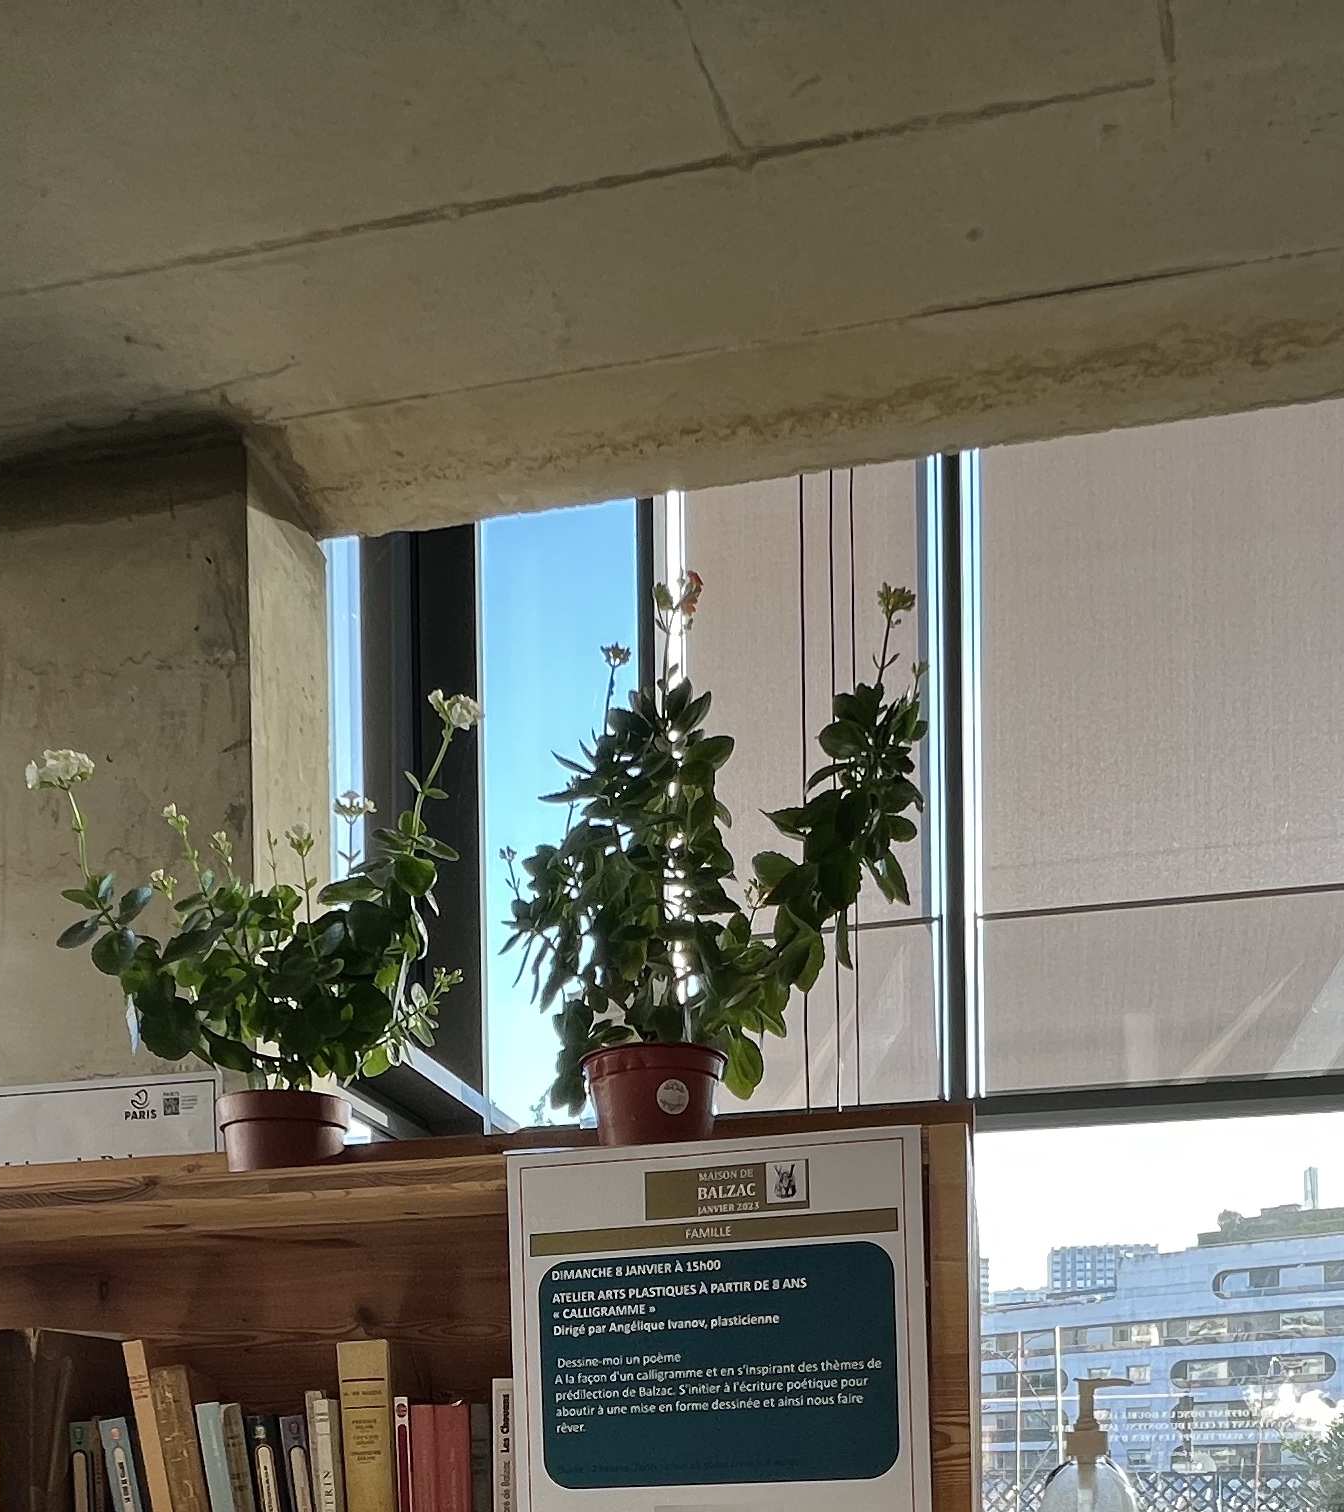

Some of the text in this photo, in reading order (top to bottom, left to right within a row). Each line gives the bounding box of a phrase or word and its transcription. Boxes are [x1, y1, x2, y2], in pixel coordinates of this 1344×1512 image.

[124, 1109, 158, 1121] PARIS
[698, 1168, 754, 1182] MAISON DE
[697, 1182, 756, 1201] BALZAC
[697, 1203, 735, 1216] JANVIER
[685, 1225, 732, 1240] FAMILLE
[551, 1259, 722, 1281] DIMANCHE 8 JANVIER À 15h00
[551, 1277, 808, 1305] ATELIER ARTS PLASTIQUES À PARTIR DE 8 ANS
[552, 1303, 656, 1320] « CALLIGRAMME »
[553, 1313, 780, 1338] Dirigé par Angélique Ivanov, plasticienne
[557, 1351, 682, 1369] Dessine-moi un poème
[565, 1373, 575, 1385] la
[577, 1372, 608, 1386] façon
[609, 1370, 634, 1382] d'un
[636, 1368, 704, 1383] calligramme
[705, 1367, 718, 1378] et
[720, 1367, 735, 1377] en
[736, 1363, 796, 1377] s'inspirant
[797, 1361, 819, 1373] des
[820, 1359, 865, 1372] thèmes
[866, 1357, 883, 1369] de
[555, 1388, 620, 1404] prédilection
[621, 1386, 637, 1398] de
[678, 1383, 722, 1396] S'initier
[723, 1381, 731, 1393] à
[732, 1380, 784, 1393] l'écriture
[786, 1377, 838, 1393] poétique
[840, 1377, 869, 1390] pour
[555, 1393, 864, 1417] aboutir à une mise en forme dessinée et ainsi nous faire
[556, 1421, 586, 1434] rêver.
[500, 1437, 510, 1454] Les
